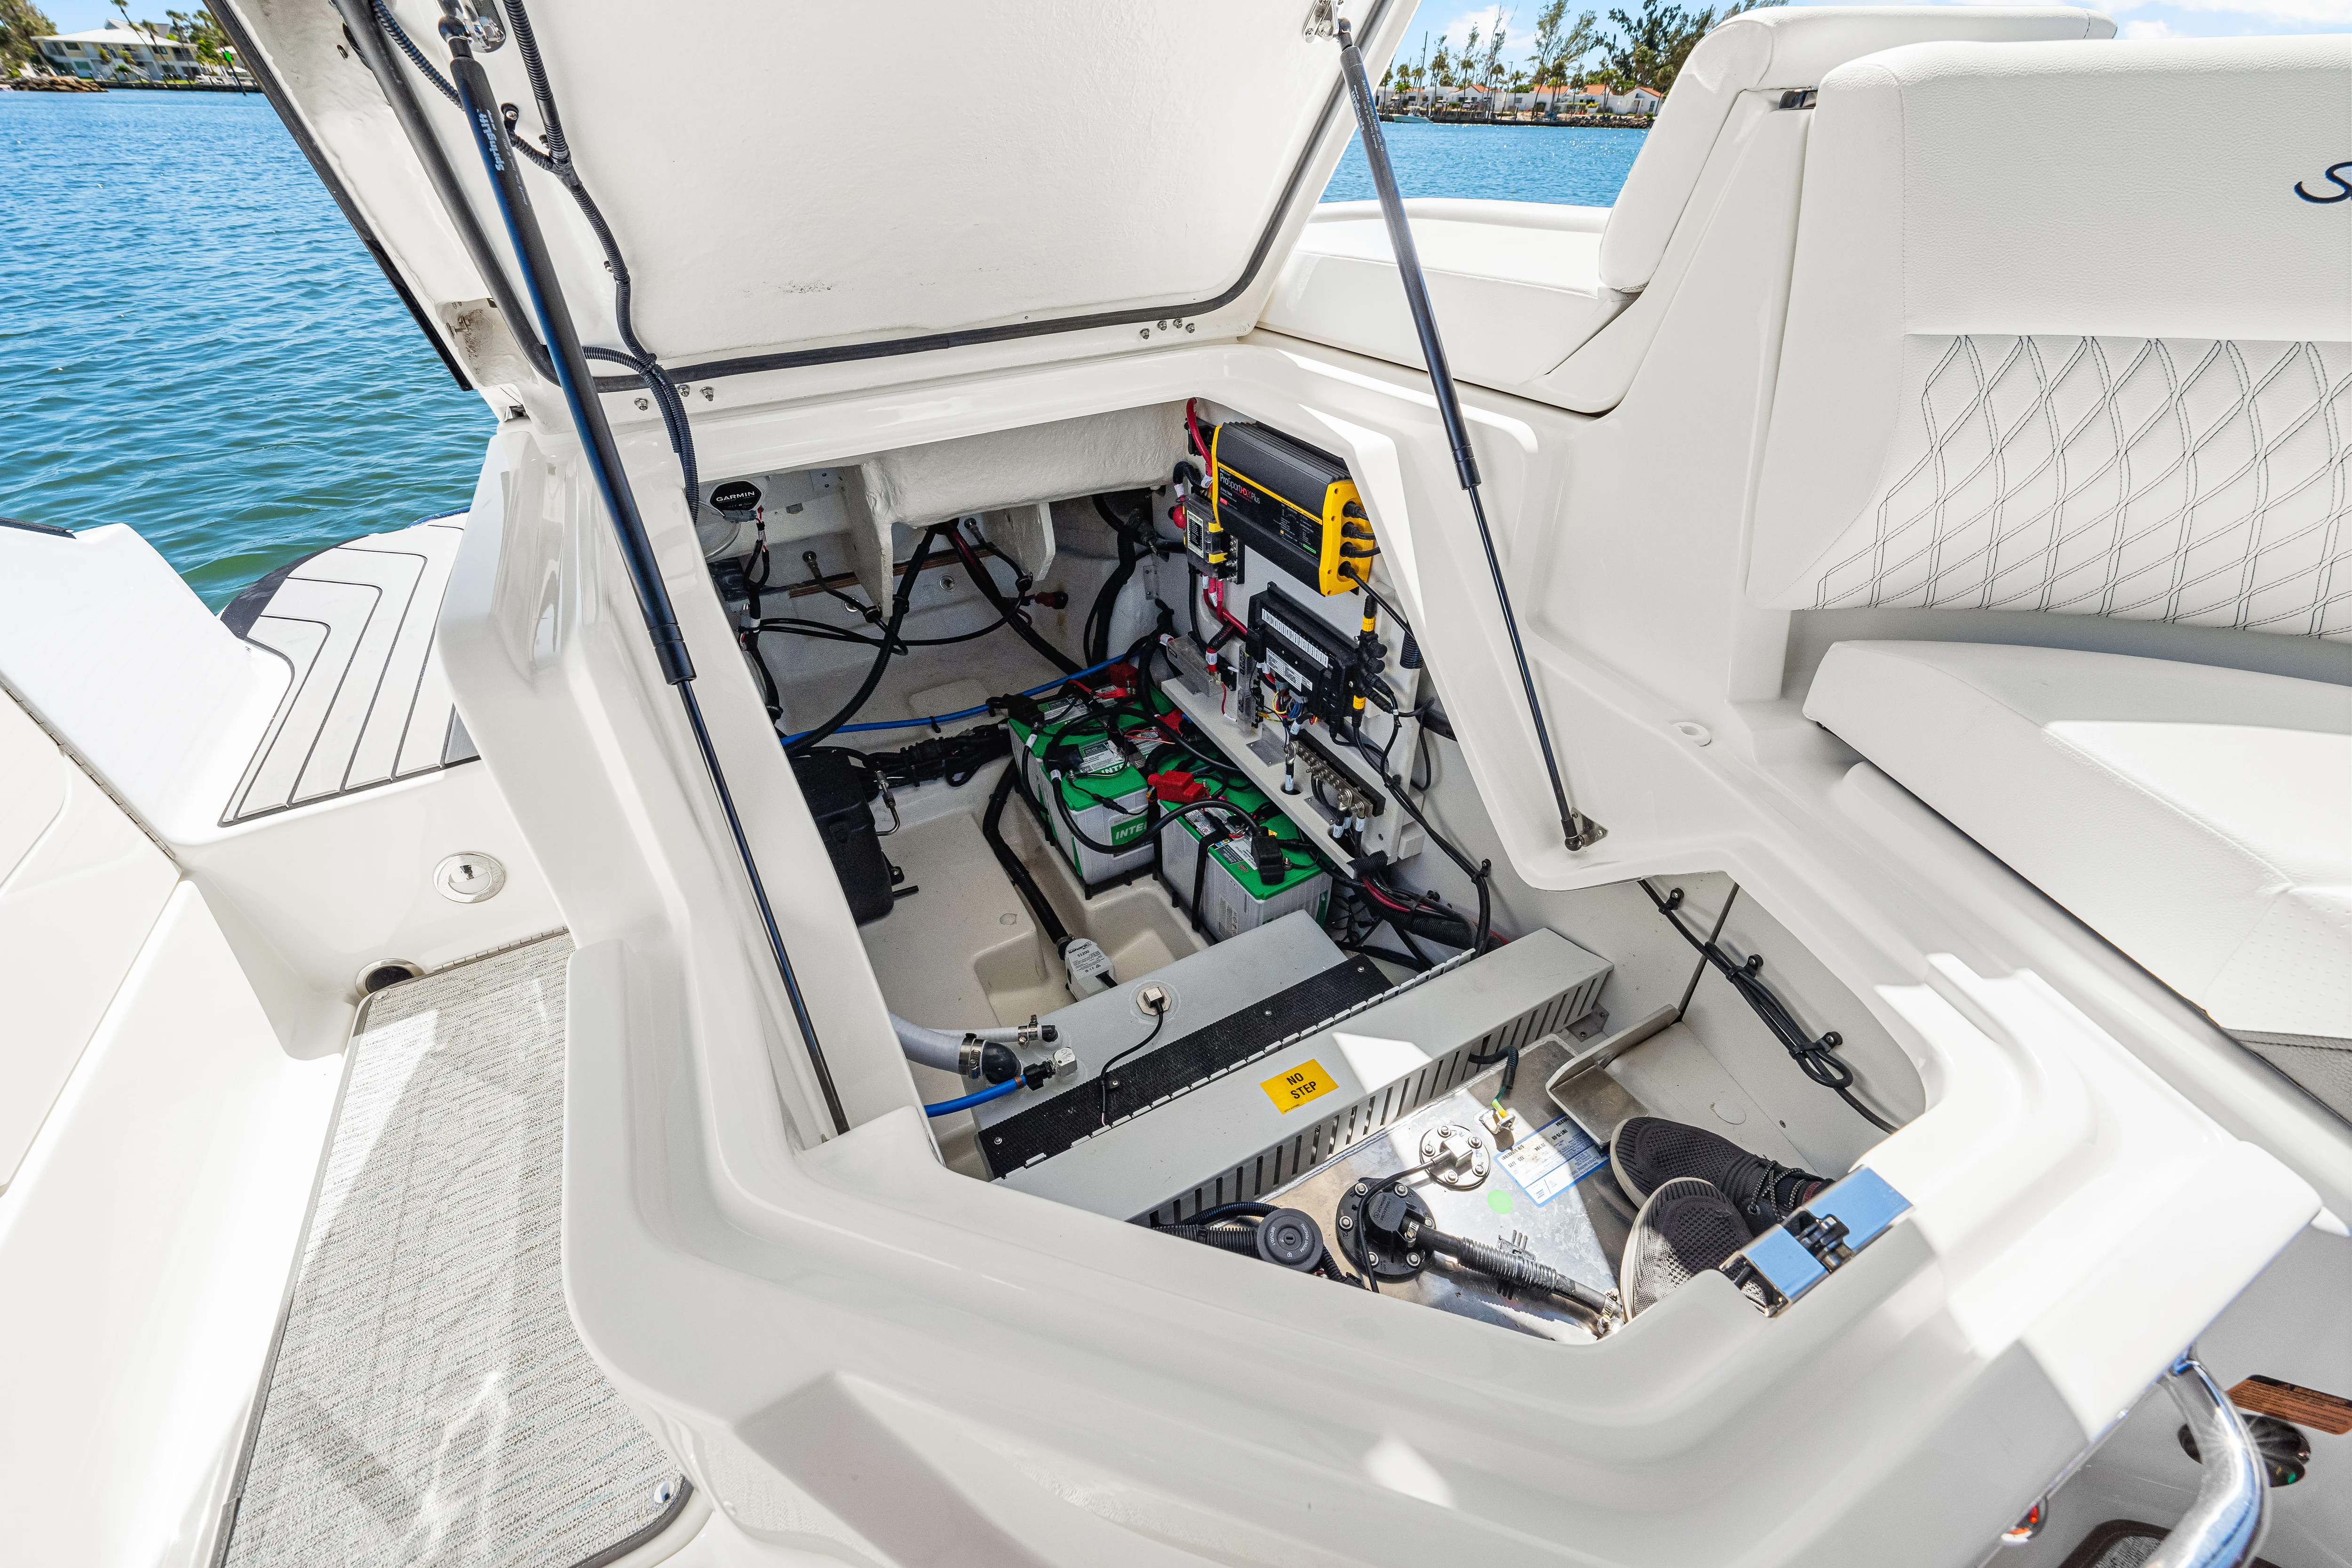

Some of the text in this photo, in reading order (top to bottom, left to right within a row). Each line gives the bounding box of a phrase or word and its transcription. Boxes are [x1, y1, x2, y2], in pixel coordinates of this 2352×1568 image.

[1362, 80, 1371, 103] PRESSURE
[716, 491, 755, 501] GARMIN
[1286, 1073, 1304, 1085] NO
[1290, 1081, 1316, 1099] STEP
[1577, 1162, 1588, 1171] MARINE
[1587, 1155, 1599, 1165] FLORIDA
[1377, 1195, 1387, 1213] attwood
[1300, 1223, 1309, 1253] PATENT PENDING
